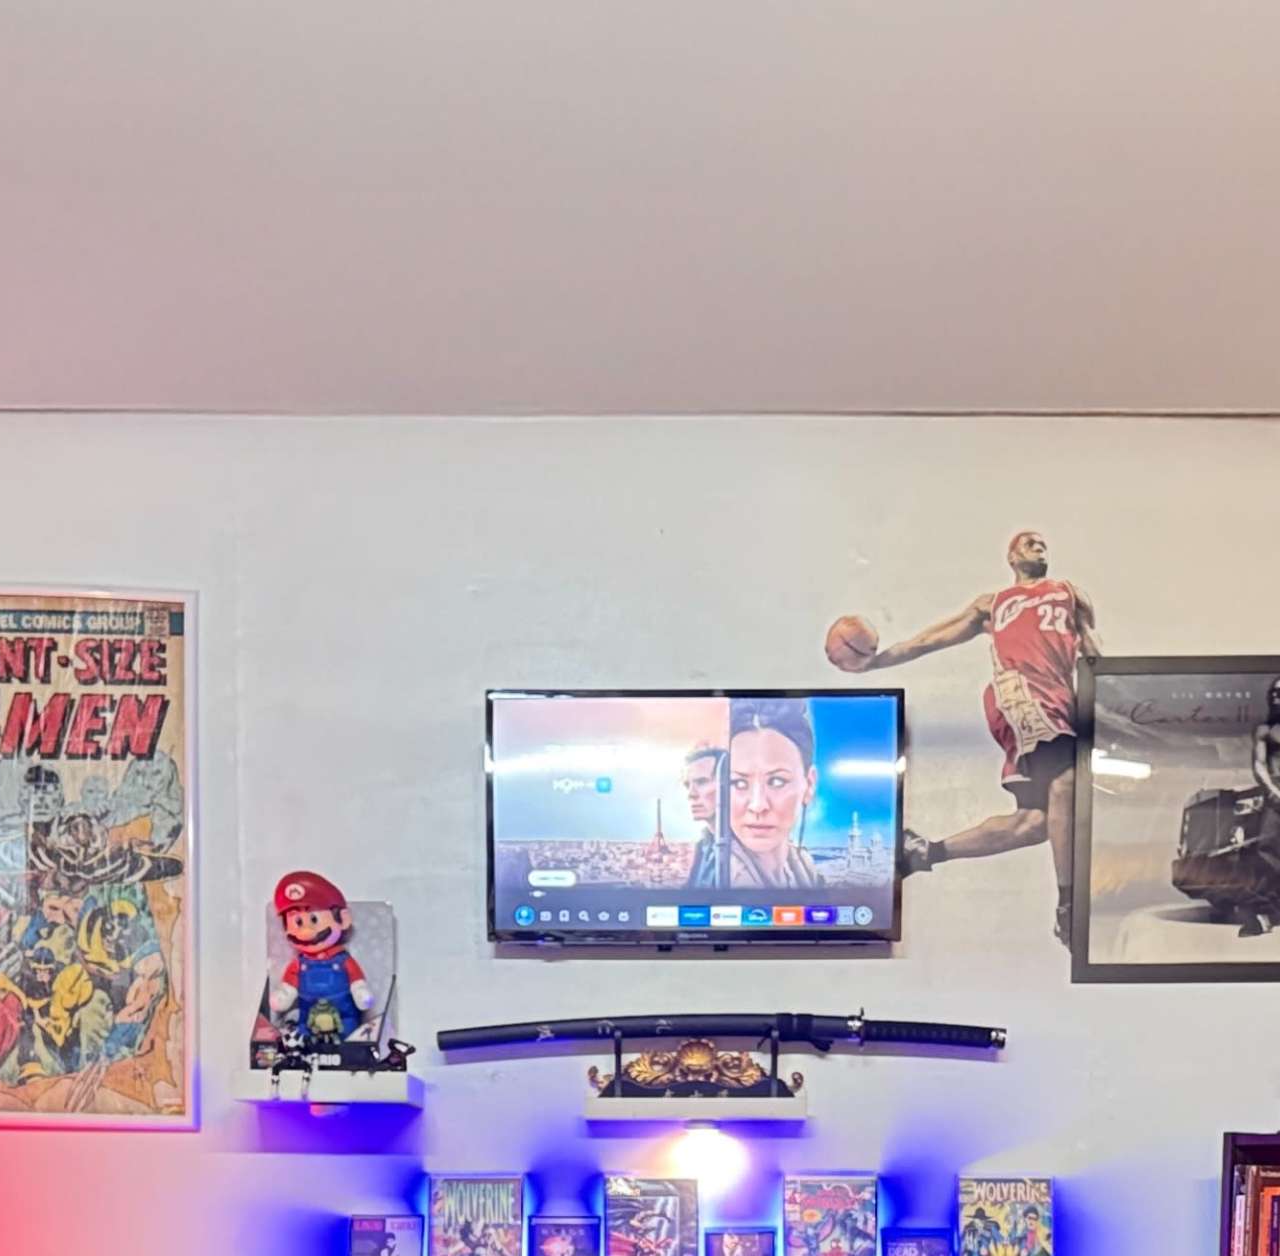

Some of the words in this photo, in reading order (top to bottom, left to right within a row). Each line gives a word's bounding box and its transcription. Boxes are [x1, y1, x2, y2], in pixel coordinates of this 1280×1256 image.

[22, 615, 81, 630] COMICS
[87, 616, 142, 632] GROUP
[442, 1182, 515, 1226] WOLVERINE
